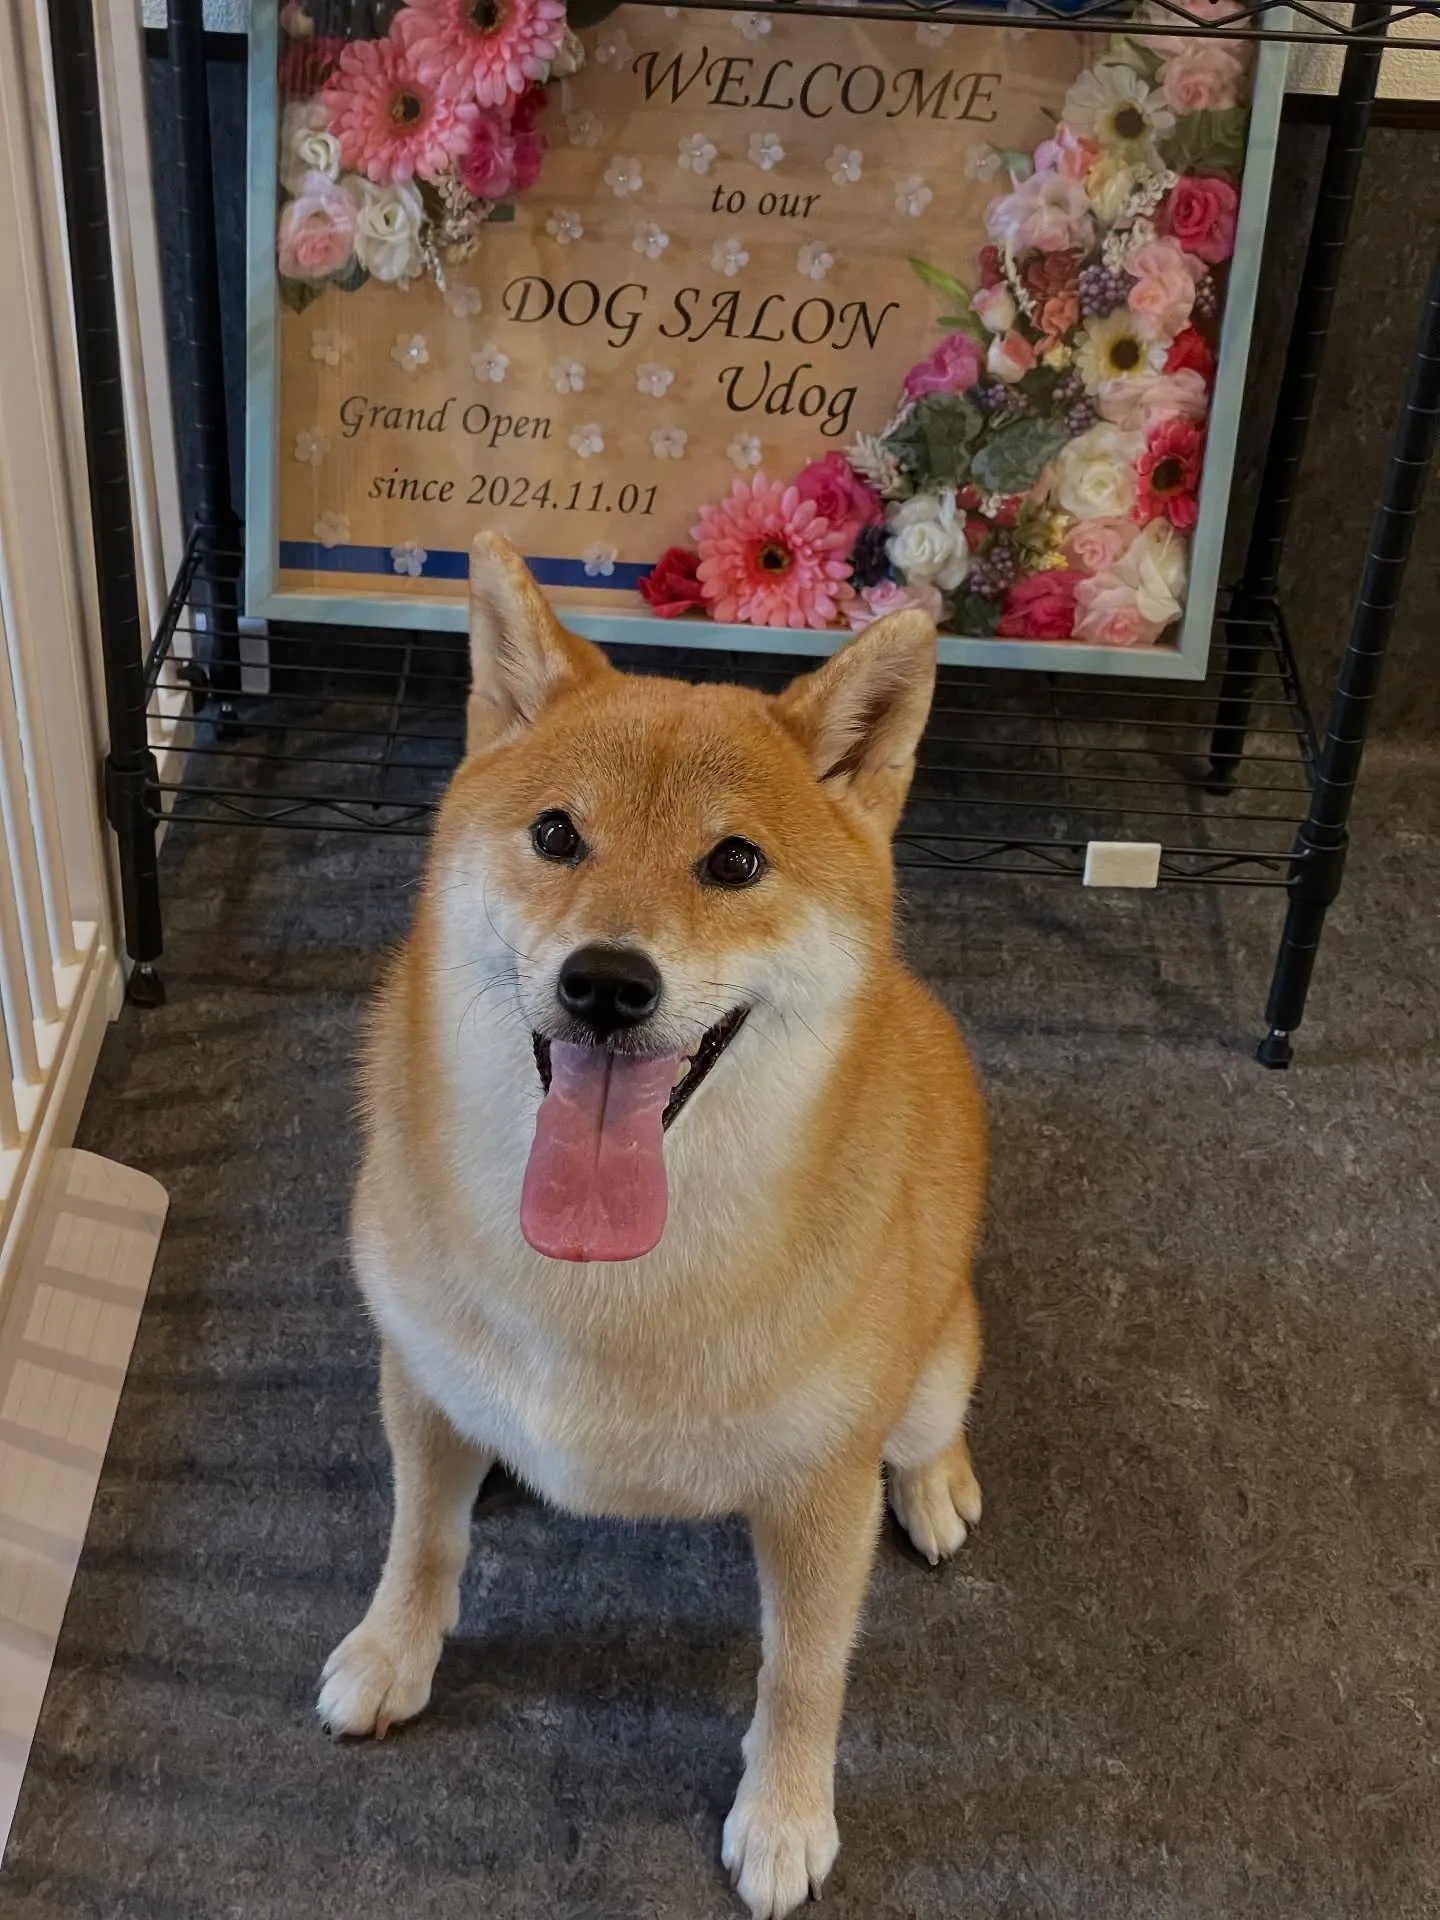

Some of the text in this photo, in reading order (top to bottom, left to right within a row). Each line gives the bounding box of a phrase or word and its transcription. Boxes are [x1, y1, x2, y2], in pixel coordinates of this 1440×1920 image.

[633, 46, 1002, 123] WELCOME
[712, 184, 822, 219] to our
[503, 276, 901, 351] DOG SALON
[340, 395, 552, 448] Grand Open
[718, 360, 858, 438] Udog
[368, 467, 658, 515] since 2024.11.01
